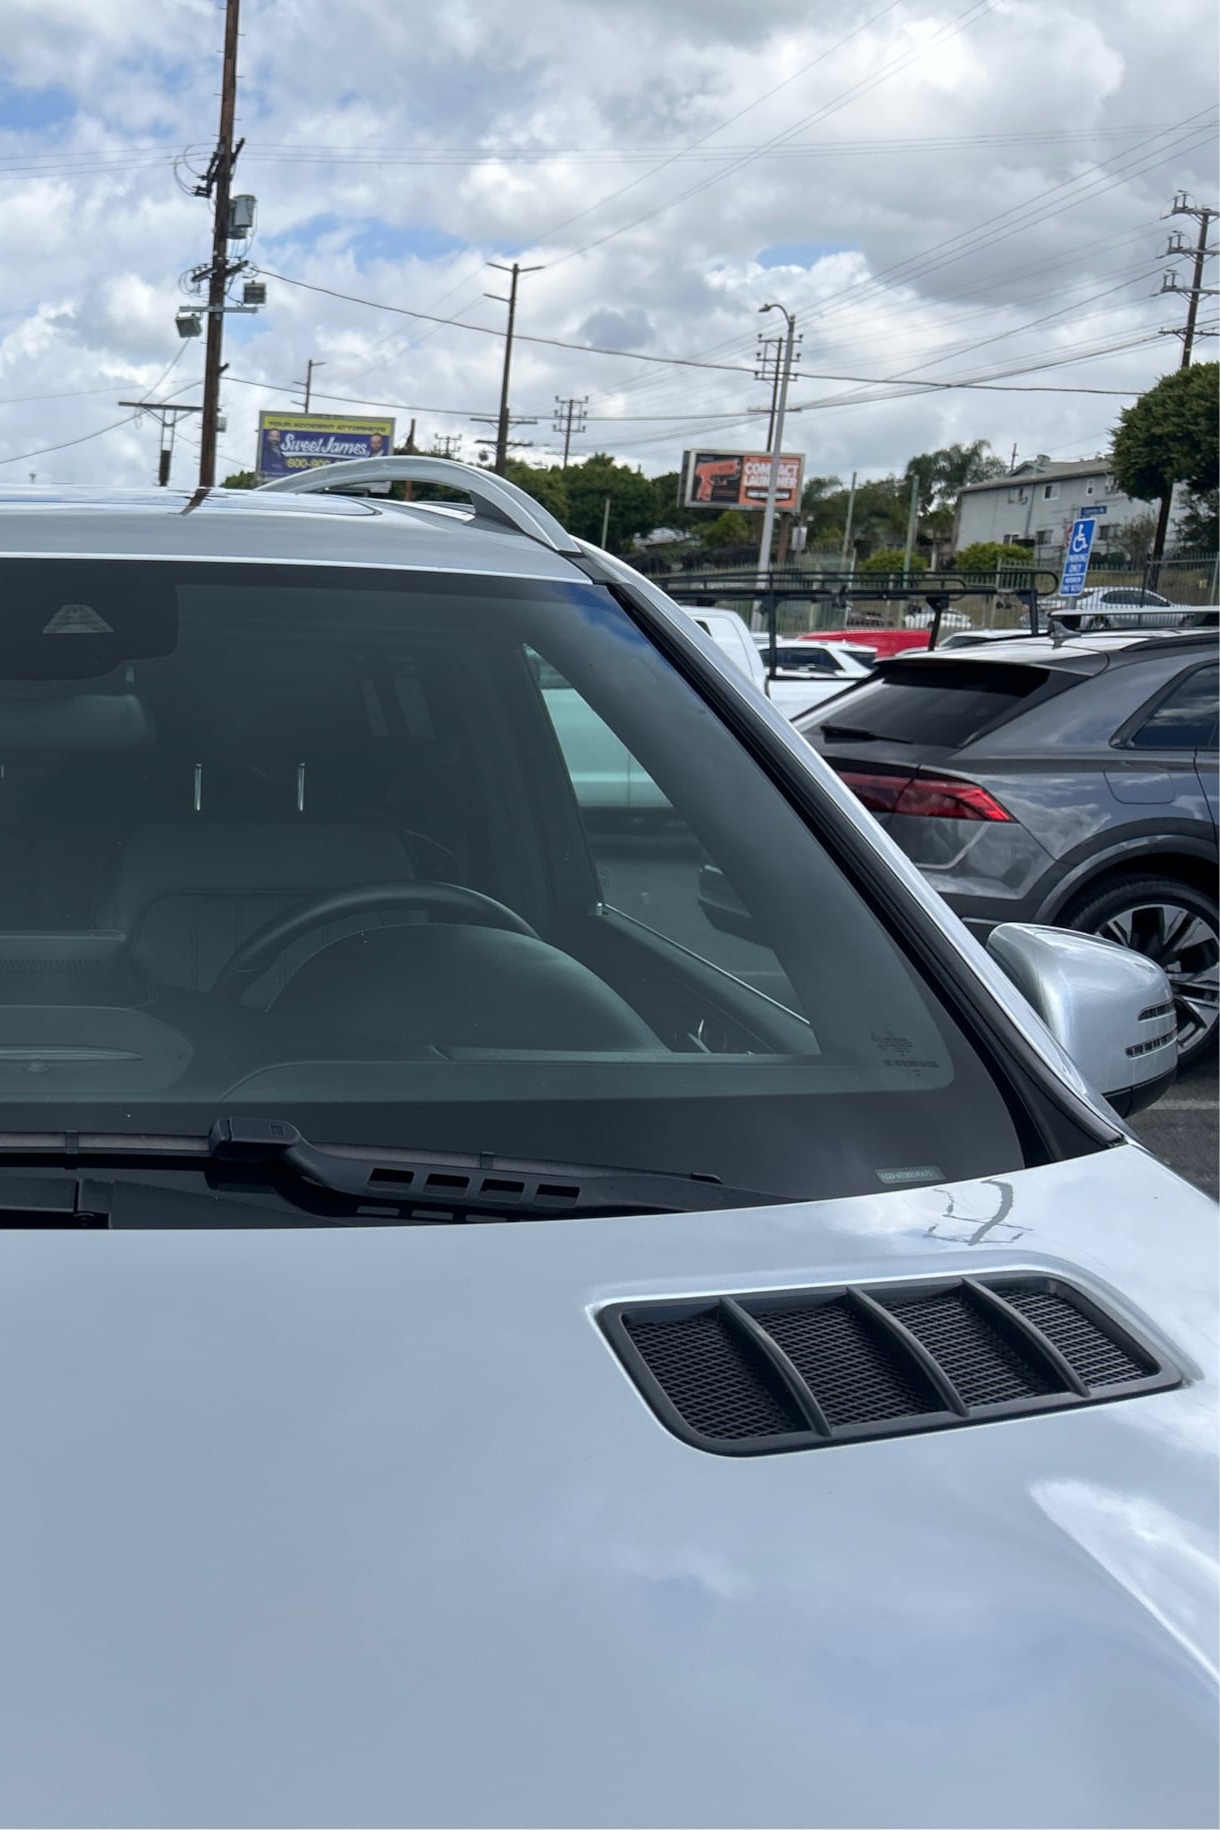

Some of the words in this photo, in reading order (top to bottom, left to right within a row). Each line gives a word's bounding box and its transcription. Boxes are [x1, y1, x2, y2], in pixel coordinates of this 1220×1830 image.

[280, 433, 324, 452] Sweet
[322, 437, 368, 455] James
[744, 462, 799, 478] COMACT
